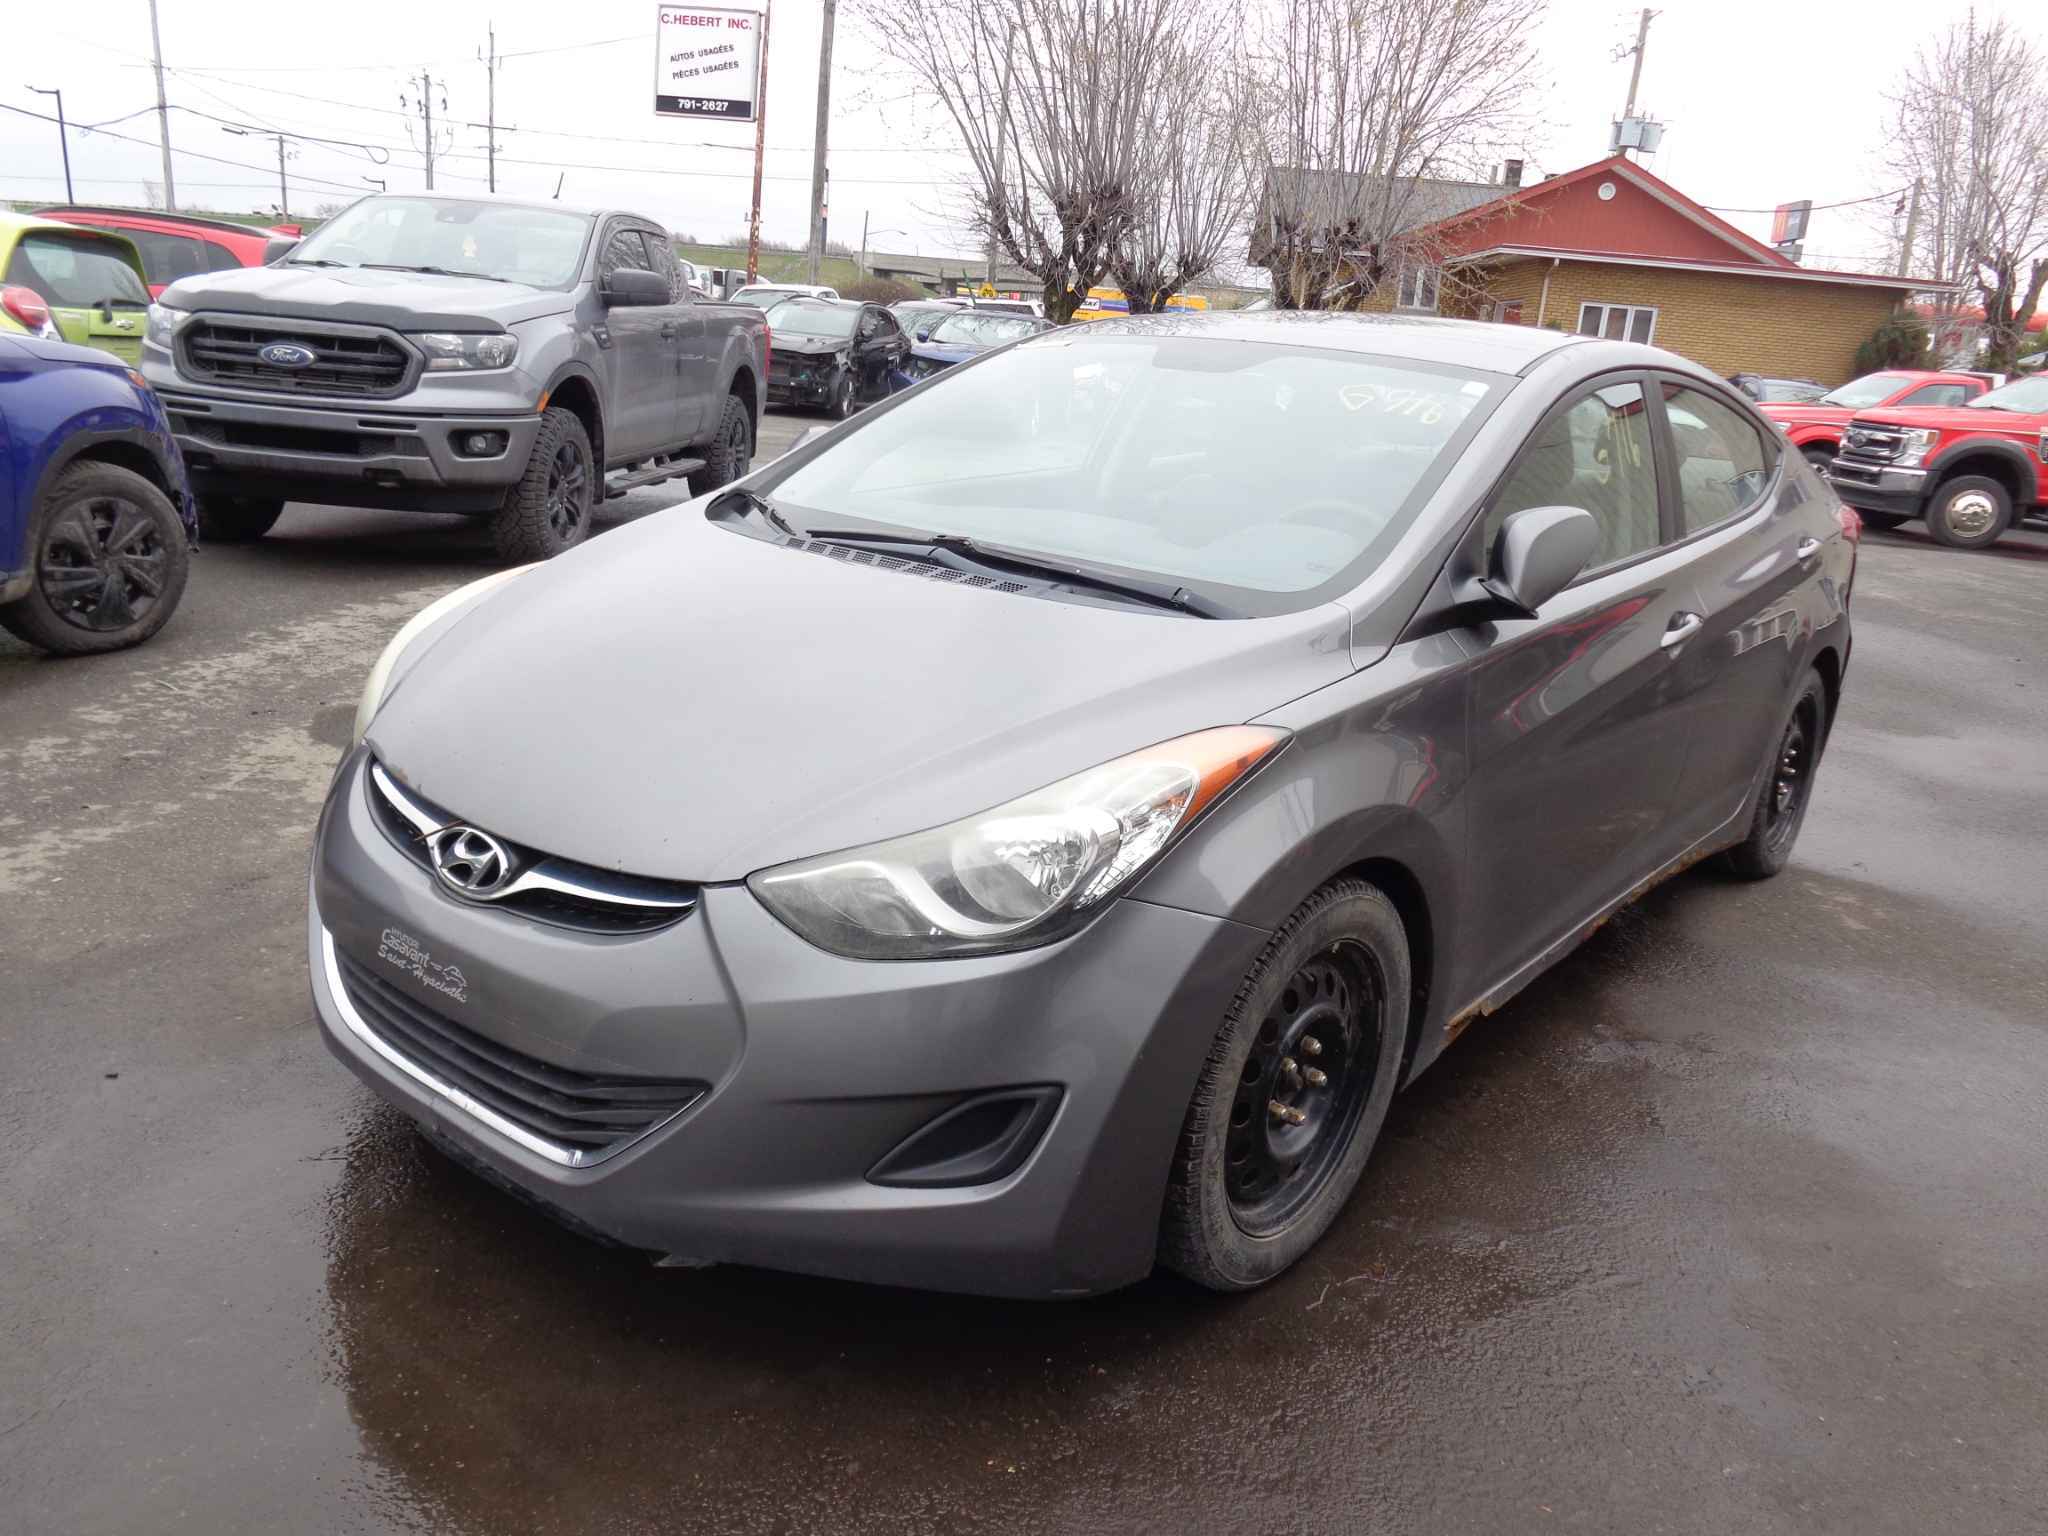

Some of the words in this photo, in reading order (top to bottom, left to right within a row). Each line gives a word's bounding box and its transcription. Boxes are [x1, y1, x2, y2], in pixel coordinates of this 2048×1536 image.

[661, 13, 722, 27] C.HEBERT
[727, 18, 752, 30] INC.
[670, 51, 695, 63] AUTOS
[270, 347, 300, 361] Ford
[382, 930, 430, 968] Casavant
